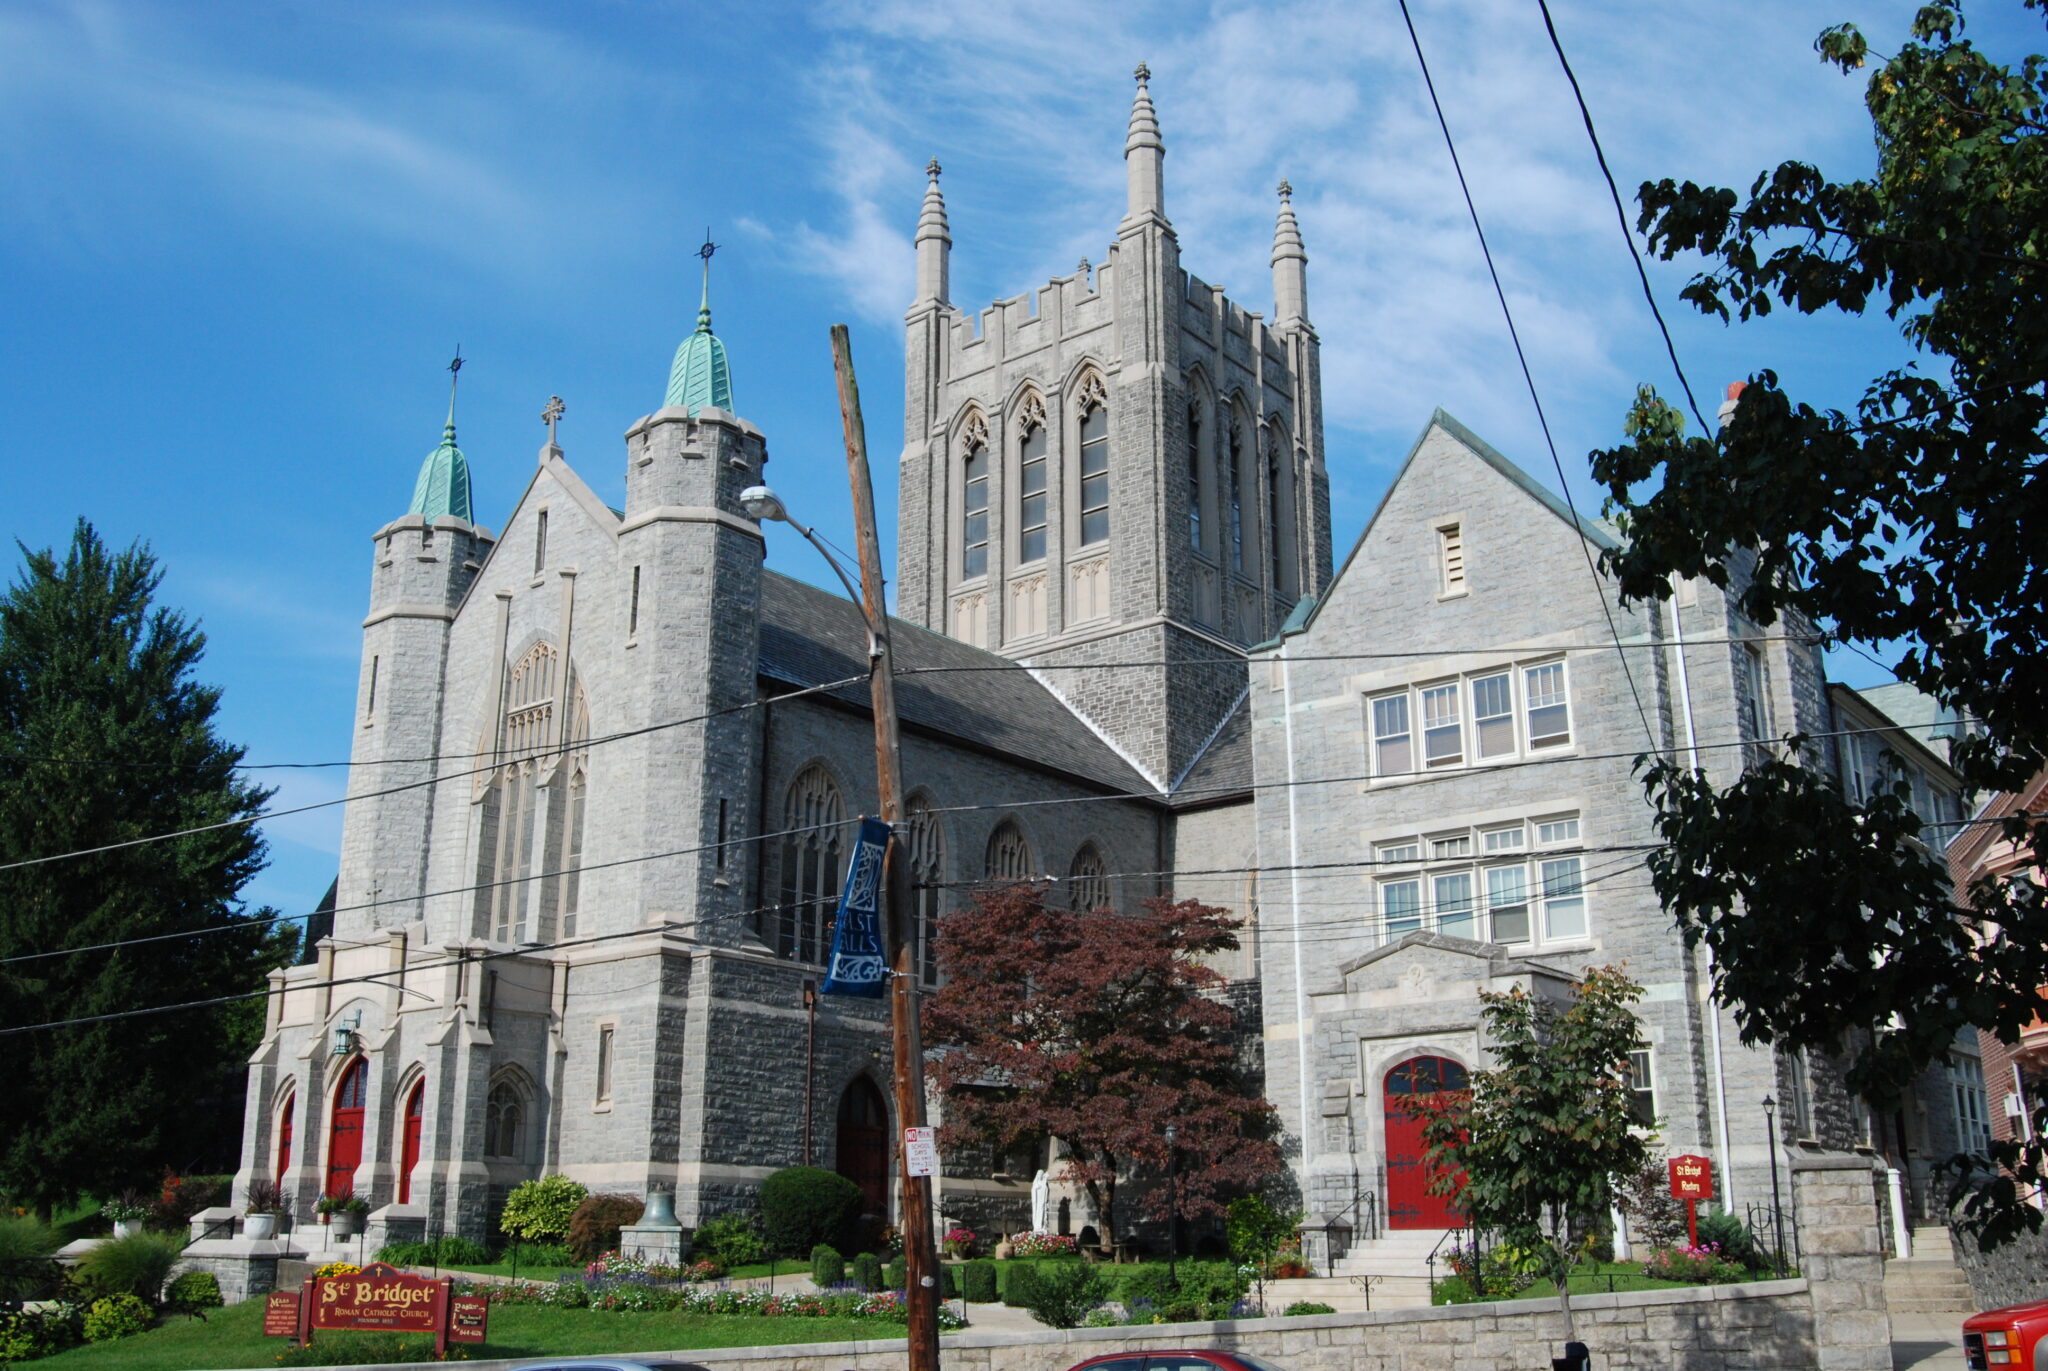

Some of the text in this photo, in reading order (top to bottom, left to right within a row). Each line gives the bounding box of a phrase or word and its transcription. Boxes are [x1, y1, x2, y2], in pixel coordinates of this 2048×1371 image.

[843, 911, 874, 932] AST
[840, 932, 878, 952] ALLS
[907, 1131, 917, 1141] NO
[322, 1281, 434, 1308] St Bridget
[335, 1307, 429, 1318] ROMAN CATHOLIC CHURCH
